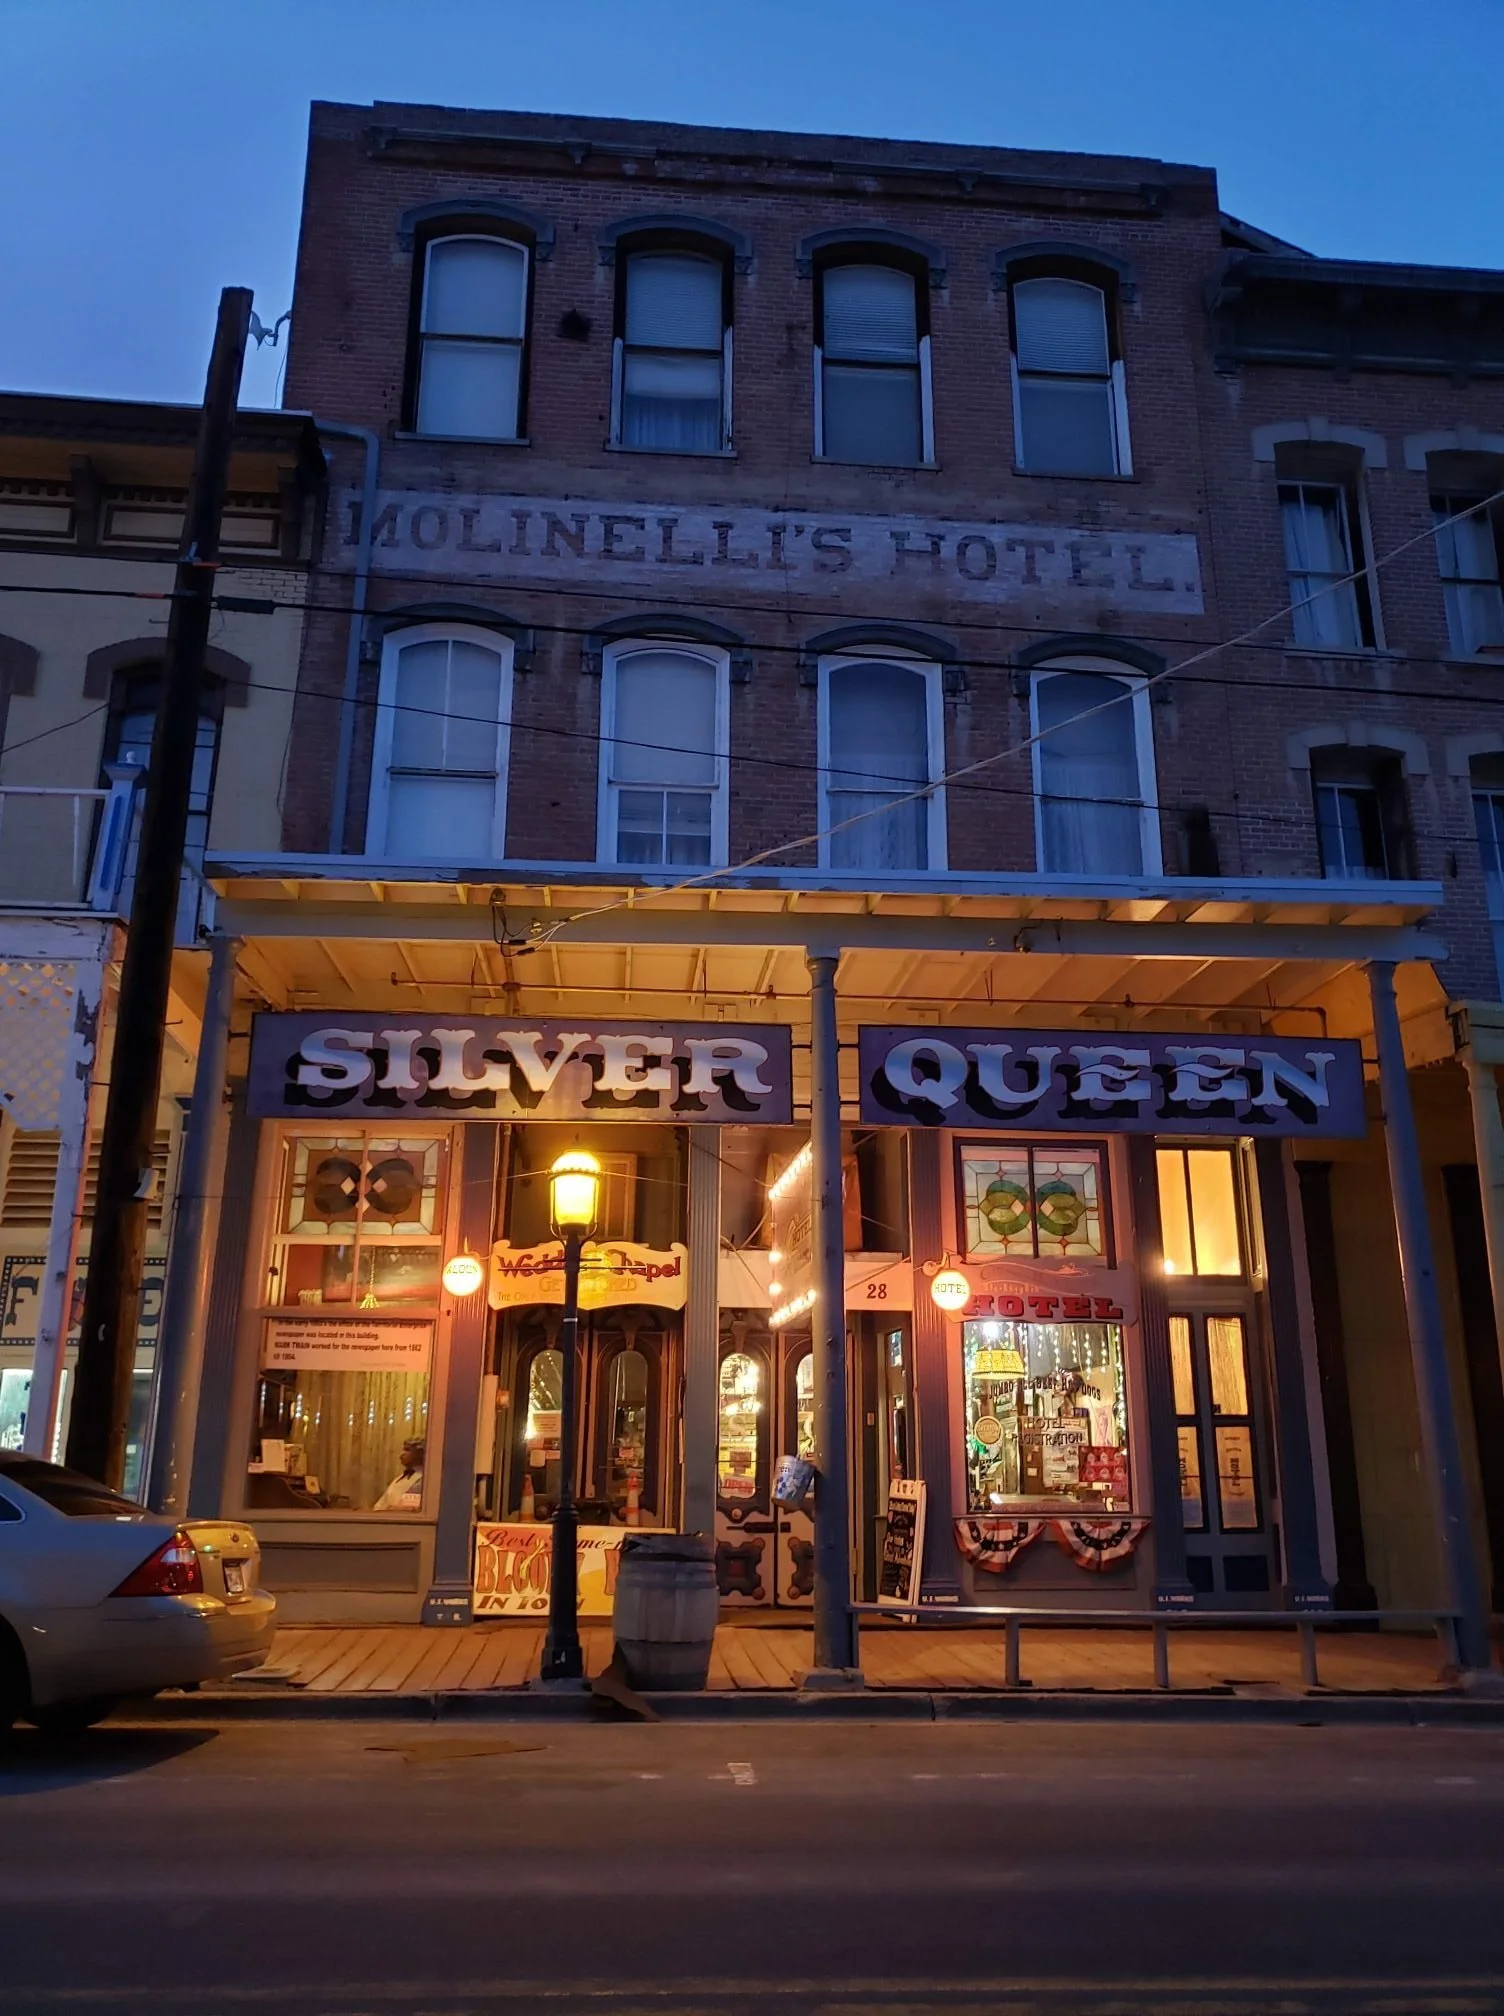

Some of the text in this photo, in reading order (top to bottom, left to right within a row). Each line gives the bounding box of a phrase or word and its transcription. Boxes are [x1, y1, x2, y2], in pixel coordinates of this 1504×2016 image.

[343, 500, 855, 576] MOLINELLI'S
[291, 1027, 773, 1104] SILVER
[880, 1037, 1338, 1114] QUEEN
[496, 1249, 580, 1279] Wedd
[866, 1283, 888, 1300] 28
[933, 1283, 967, 1295] HOTEL
[962, 1294, 1124, 1320] HOTEL
[476, 1595, 511, 1610] IN
